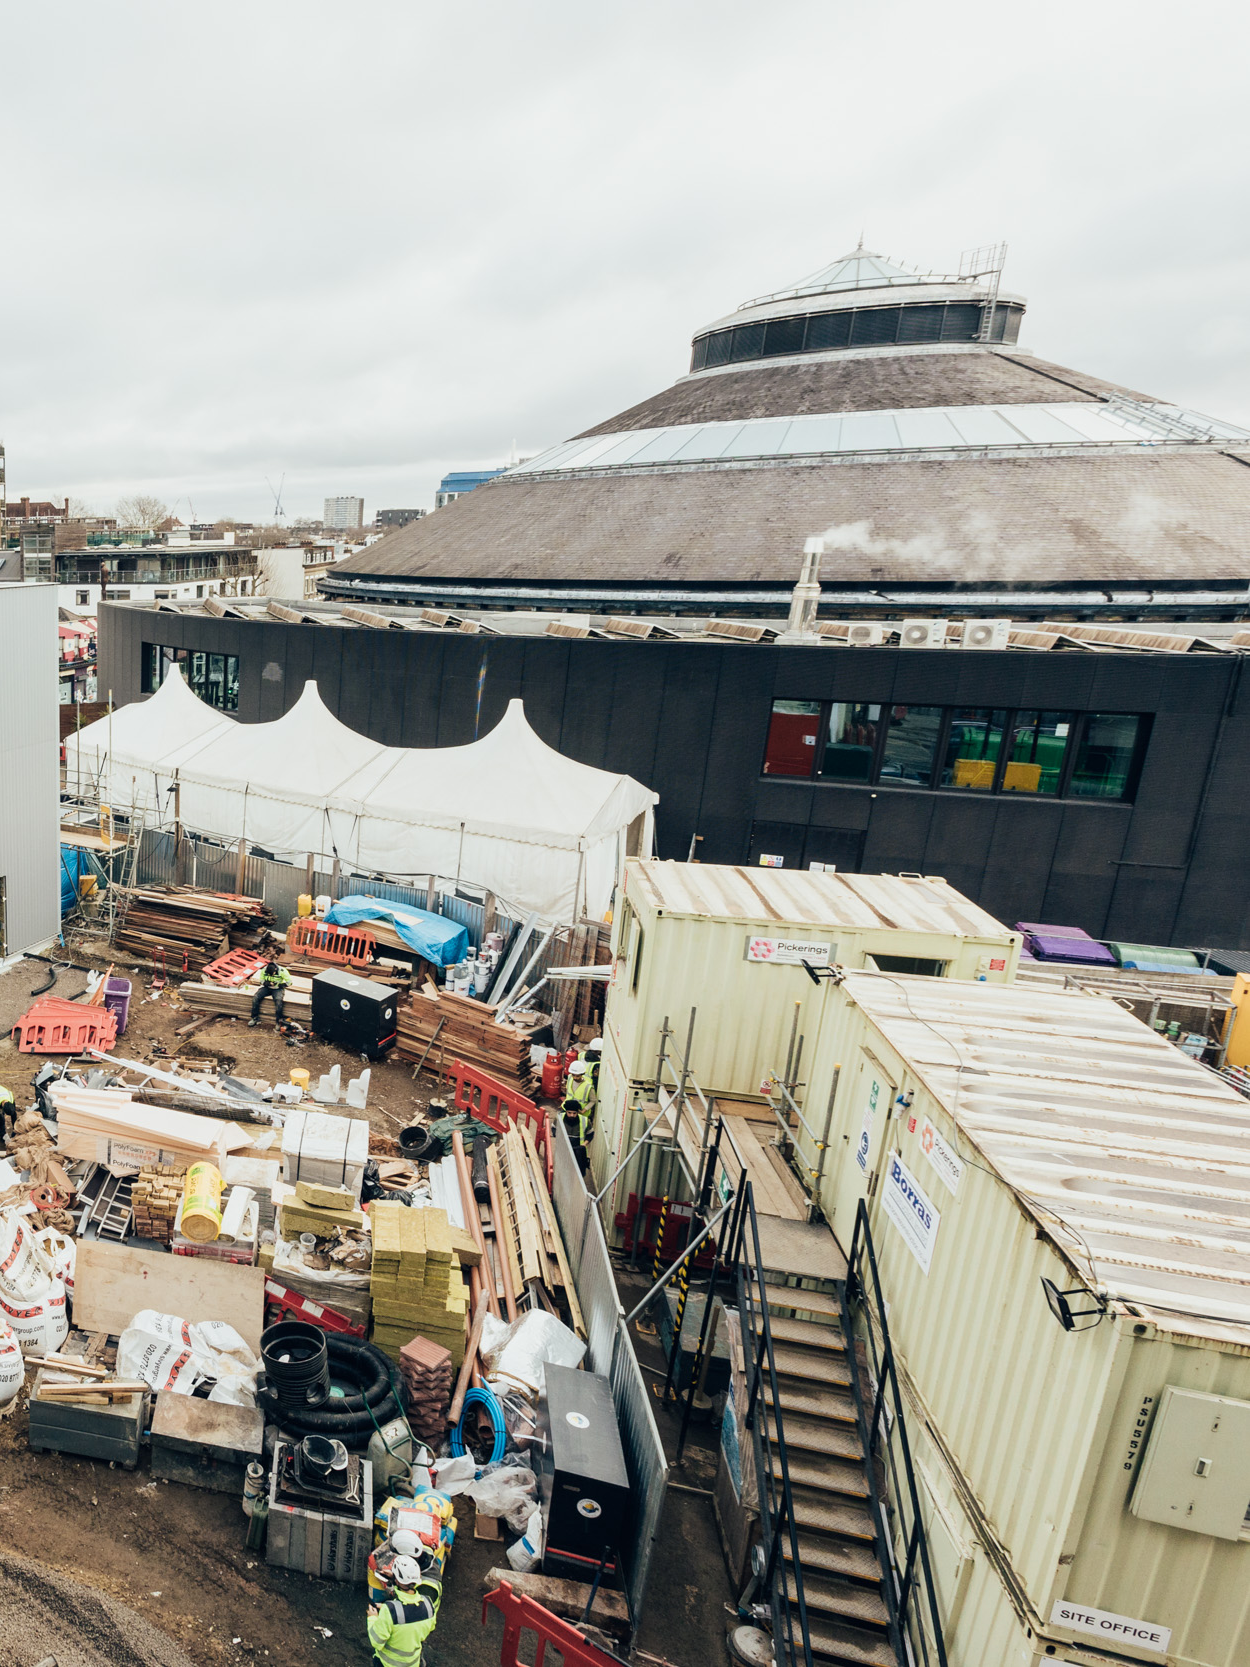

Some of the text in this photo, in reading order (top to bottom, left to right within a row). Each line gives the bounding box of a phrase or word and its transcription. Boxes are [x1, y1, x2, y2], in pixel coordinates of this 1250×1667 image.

[777, 942, 828, 955] Pickerings
[891, 1160, 931, 1230] Borras
[23, 1338, 39, 1348] 1384
[1123, 1396, 1153, 1471] PSU5579
[327, 1529, 338, 1563] Marshalls
[1060, 1609, 1161, 1643] SITE OFFICE
